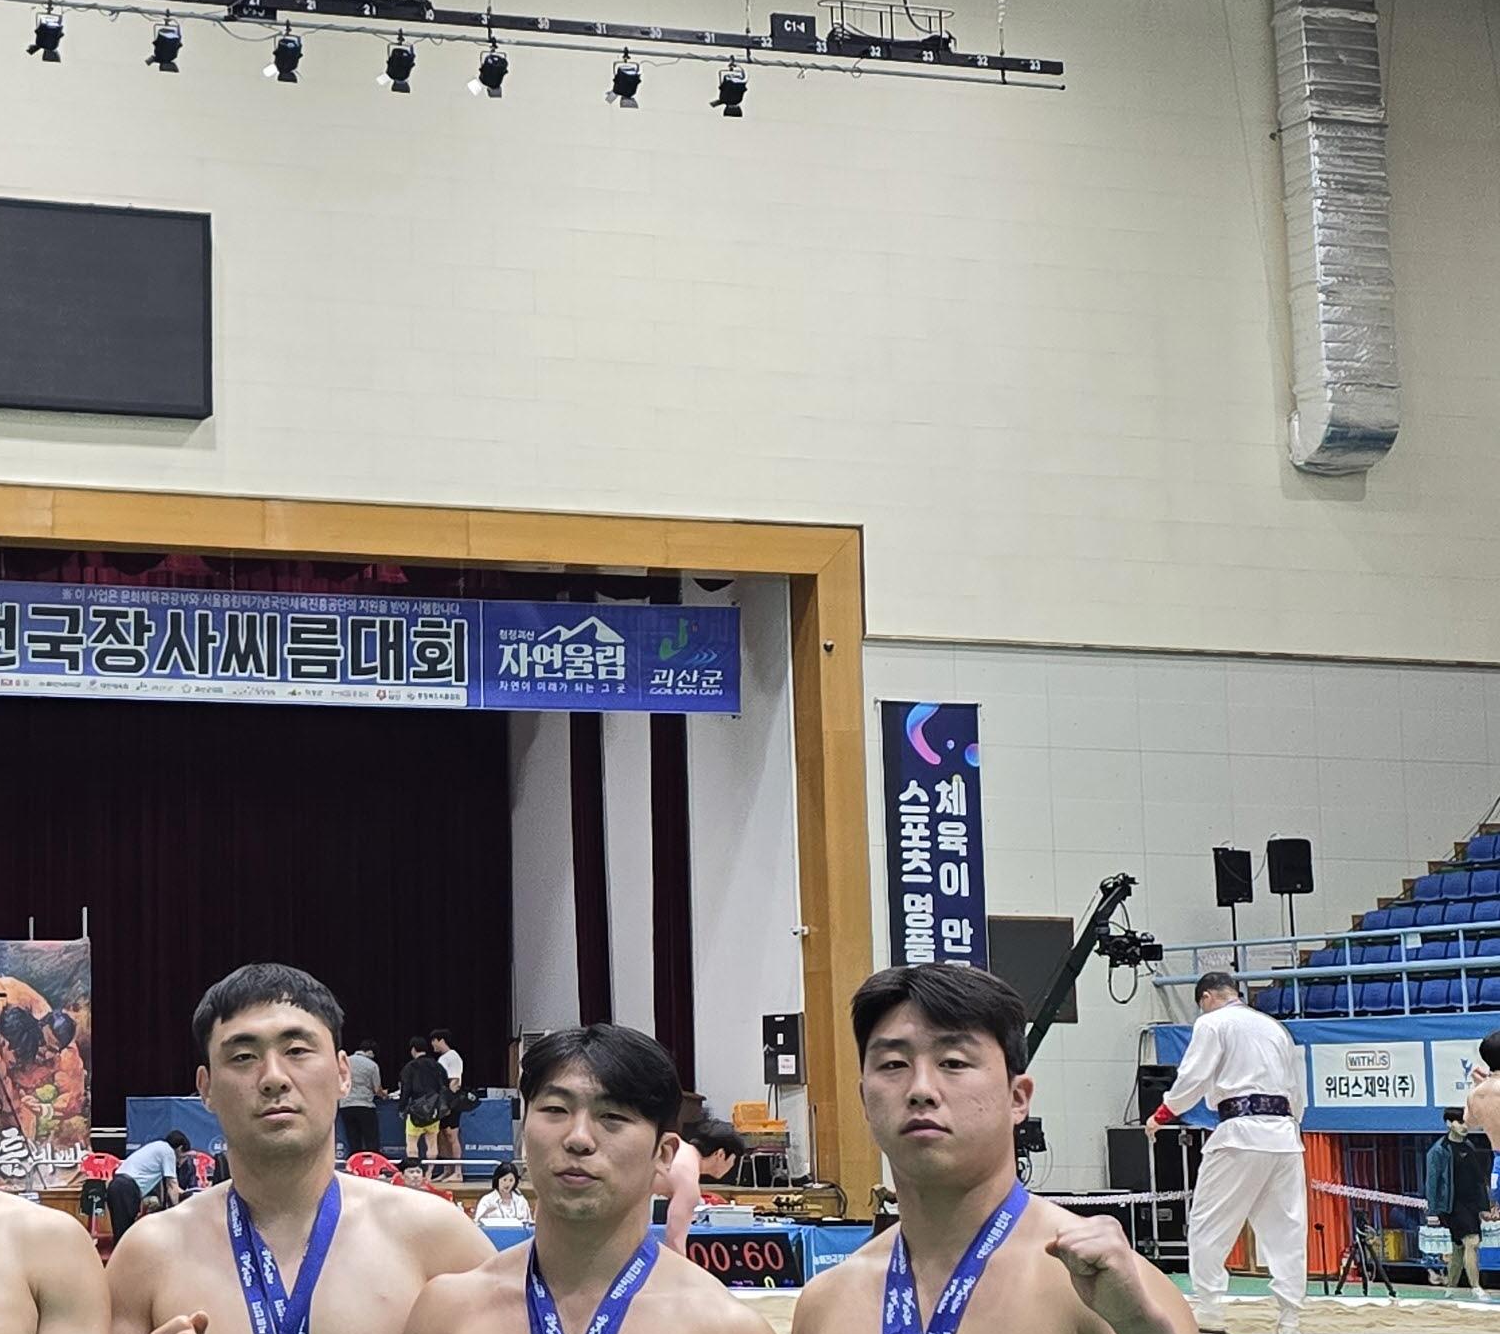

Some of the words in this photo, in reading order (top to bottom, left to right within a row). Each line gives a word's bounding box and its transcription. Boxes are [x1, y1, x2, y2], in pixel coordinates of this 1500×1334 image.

[498, 643, 625, 680] 자연울림
[650, 668, 723, 688] 괴산군
[898, 779, 934, 884] 스포츠
[934, 776, 970, 898] 체육이
[941, 918, 974, 967] 만
